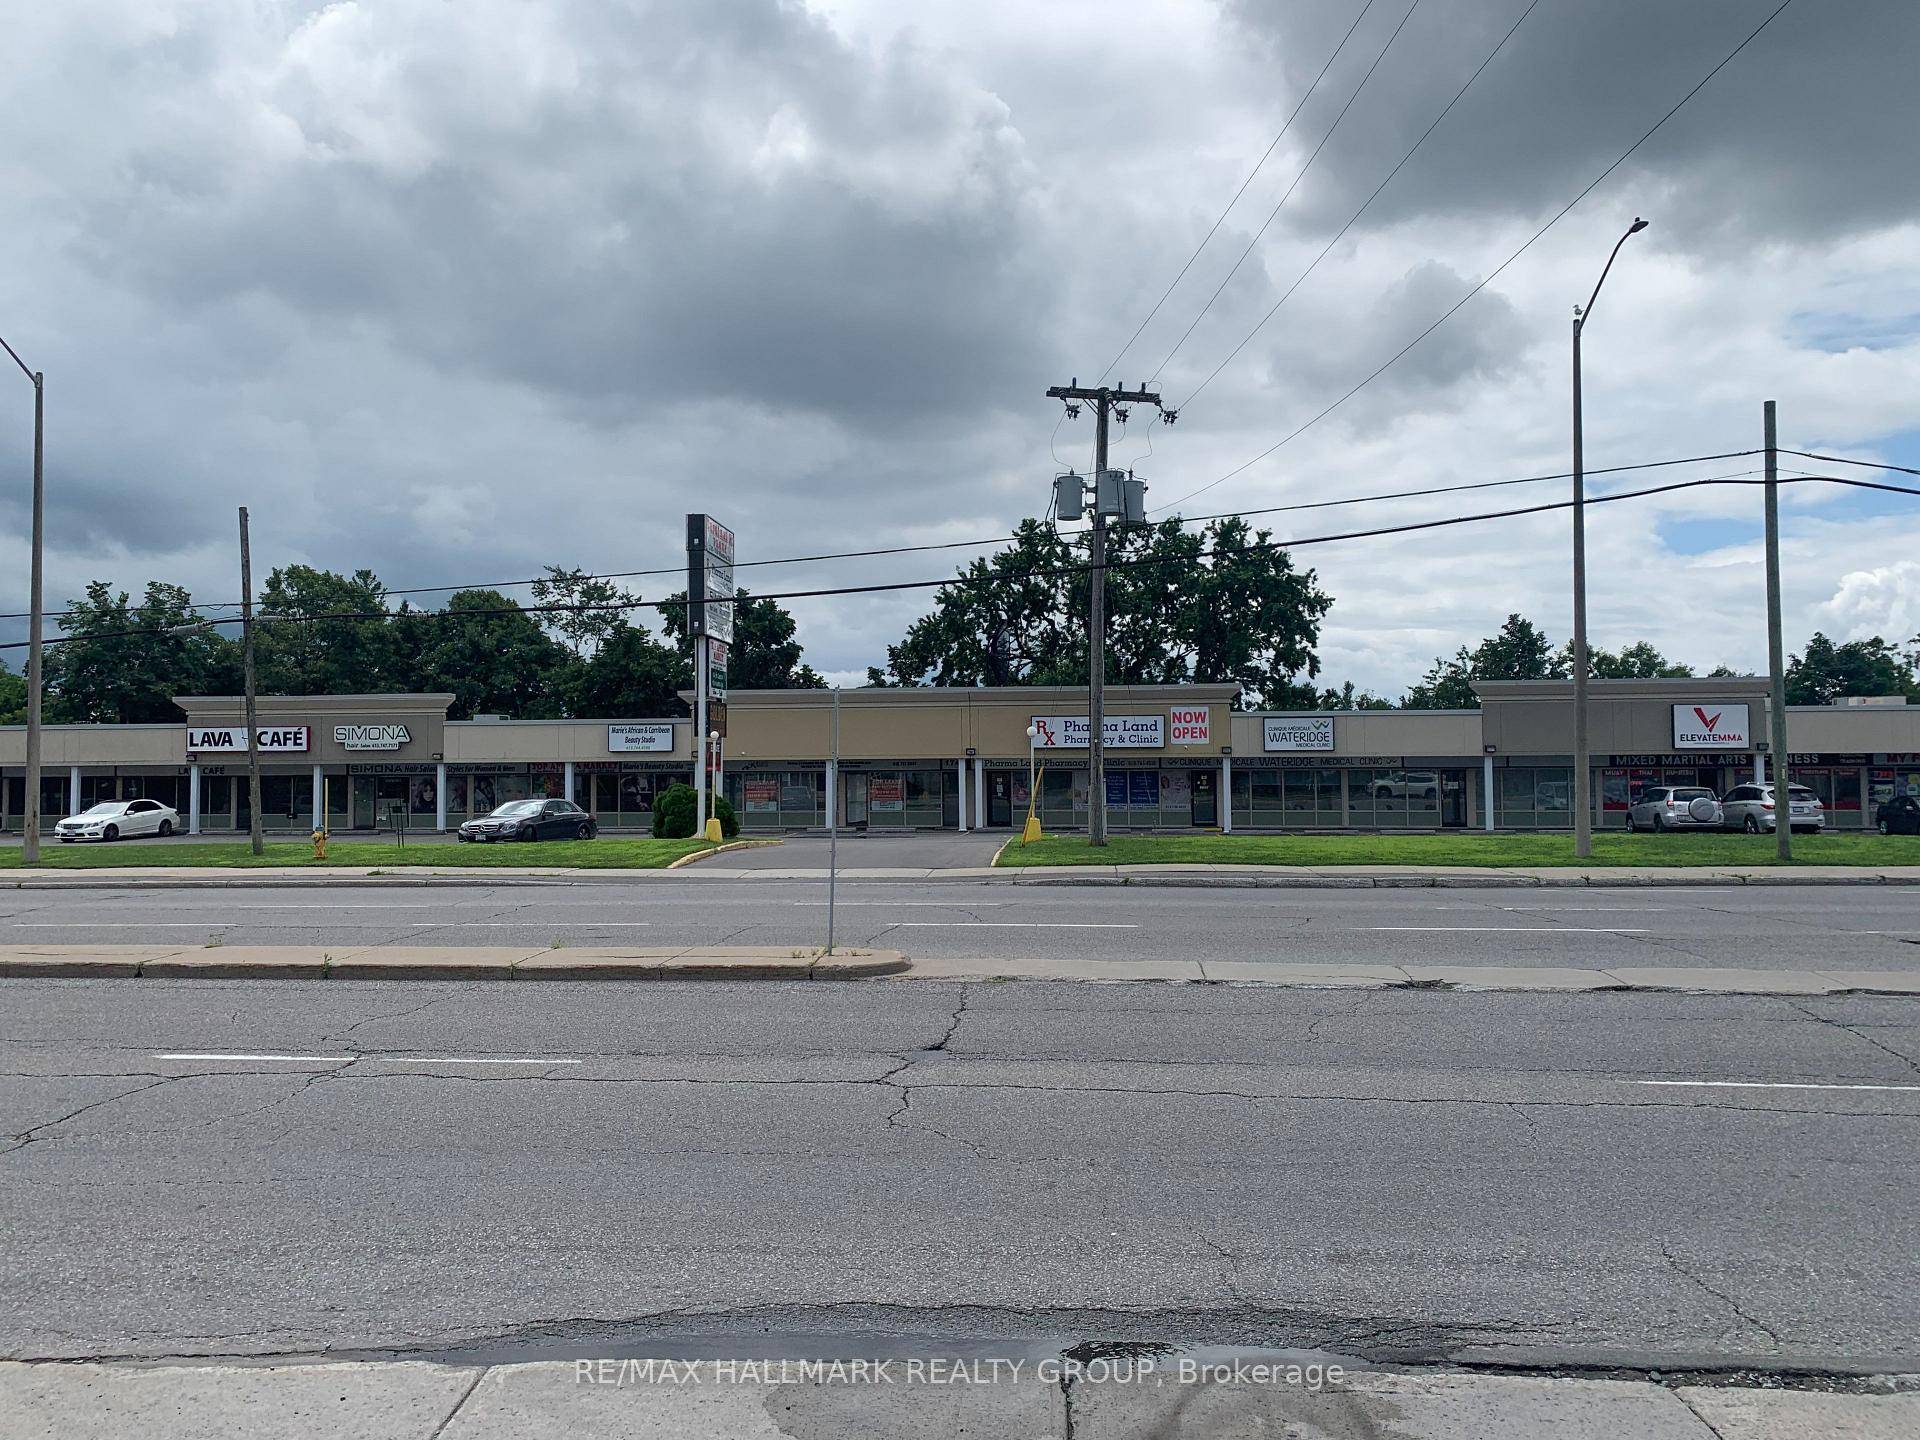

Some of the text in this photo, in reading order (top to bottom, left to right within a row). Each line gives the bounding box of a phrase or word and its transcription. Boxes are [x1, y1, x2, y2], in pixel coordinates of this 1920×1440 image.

[1172, 712, 1207, 724] NOW
[1064, 720, 1159, 732] Phaa Land
[189, 728, 304, 748] LAVA CAFÉ
[336, 727, 408, 741] SIMONA
[1172, 727, 1208, 740] OPEN
[1268, 732, 1330, 743] WATERIDGE
[1064, 734, 1159, 746] Pharcy & Clinic
[985, 759, 1018, 768] Pharma
[1260, 757, 1315, 767] WATERIDGE
[1320, 758, 1355, 766] MEDICAL
[1617, 755, 1656, 765] MIXED
[1662, 755, 1713, 765] MARTIAL
[1718, 755, 1748, 765] ARTS
[351, 764, 402, 774] SIMONA
